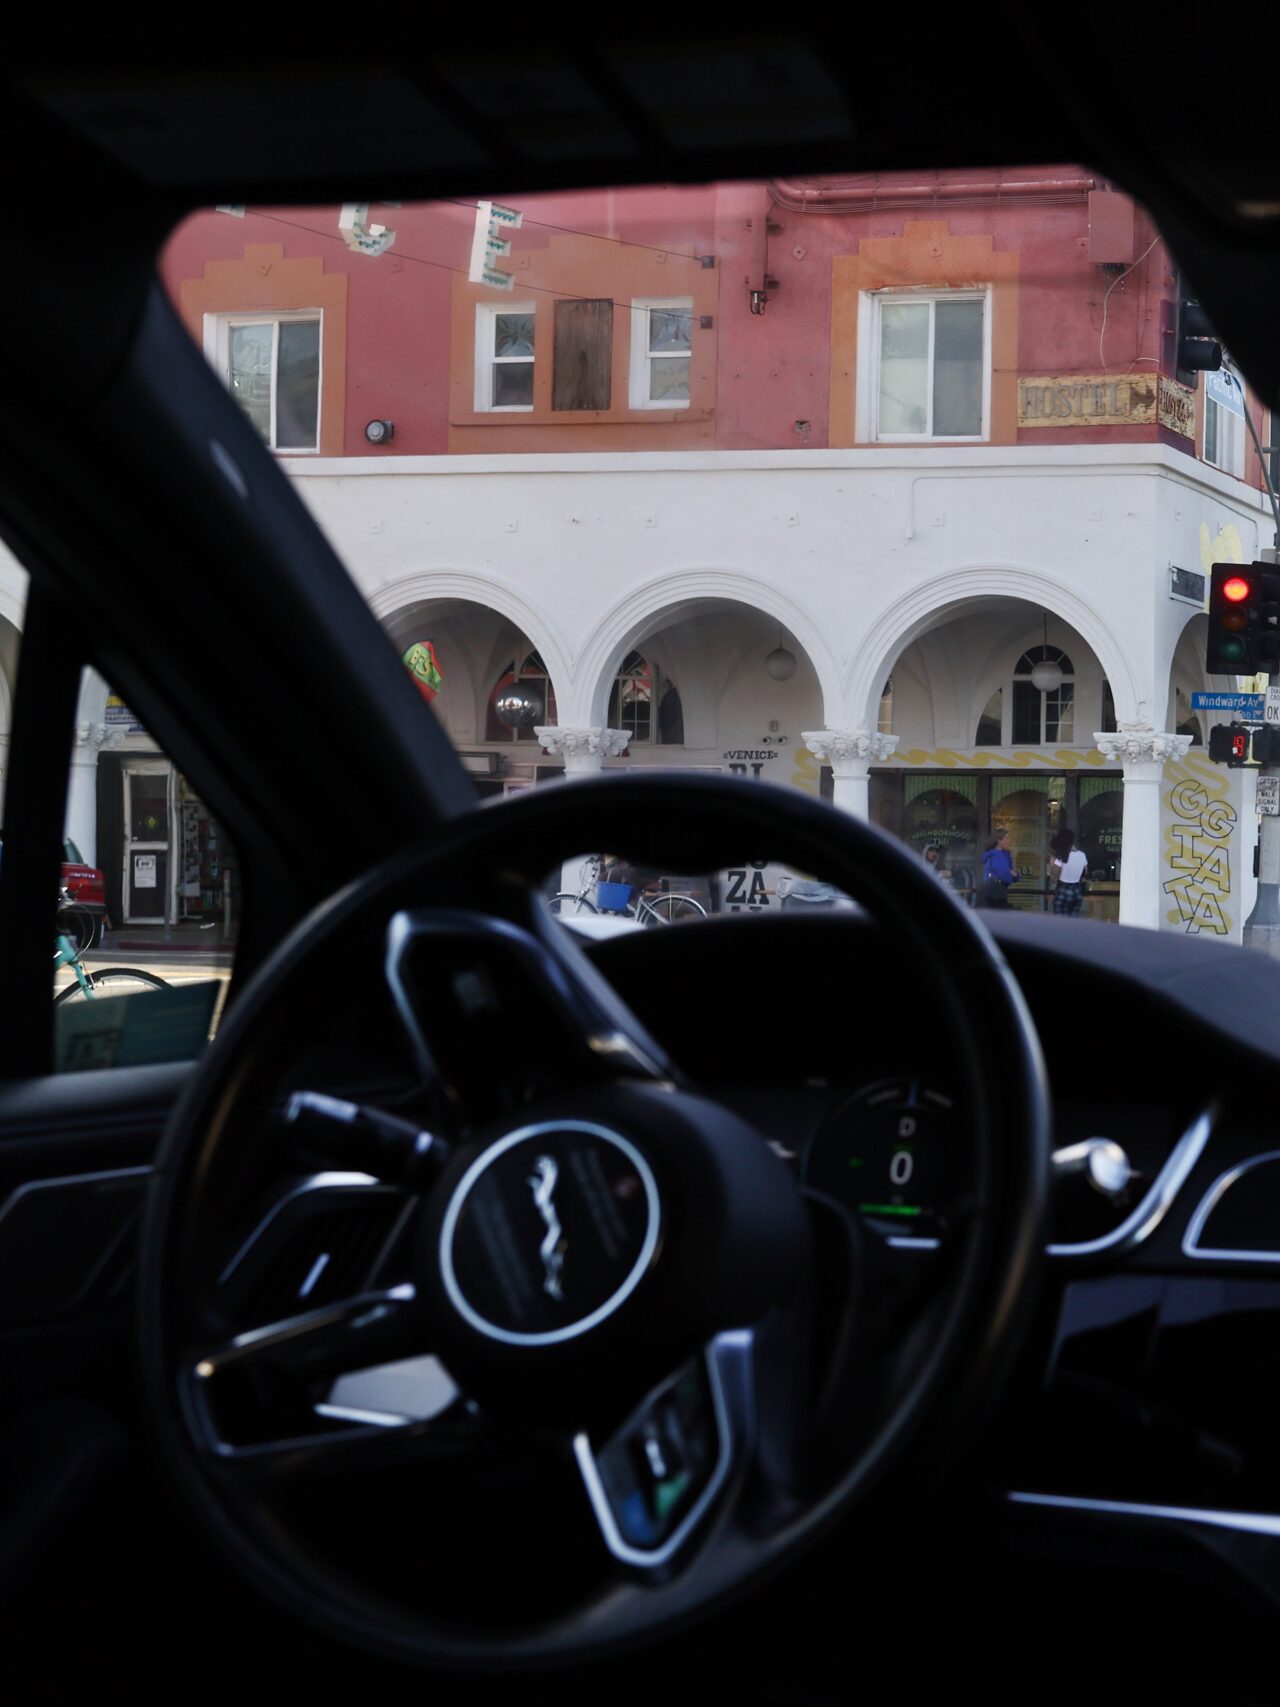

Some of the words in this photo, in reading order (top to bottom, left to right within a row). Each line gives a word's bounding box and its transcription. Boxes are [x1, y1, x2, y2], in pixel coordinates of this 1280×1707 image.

[1020, 382, 1126, 419] HOSTEL
[1198, 695, 1245, 709] Windward
[1246, 697, 1259, 707] Av
[1266, 705, 1279, 721] OK
[728, 750, 774, 760] VENICE
[1163, 779, 1237, 935] GGIATA
[726, 871, 770, 905] ZA
[899, 1117, 917, 1138] D
[888, 1150, 914, 1186] 0
